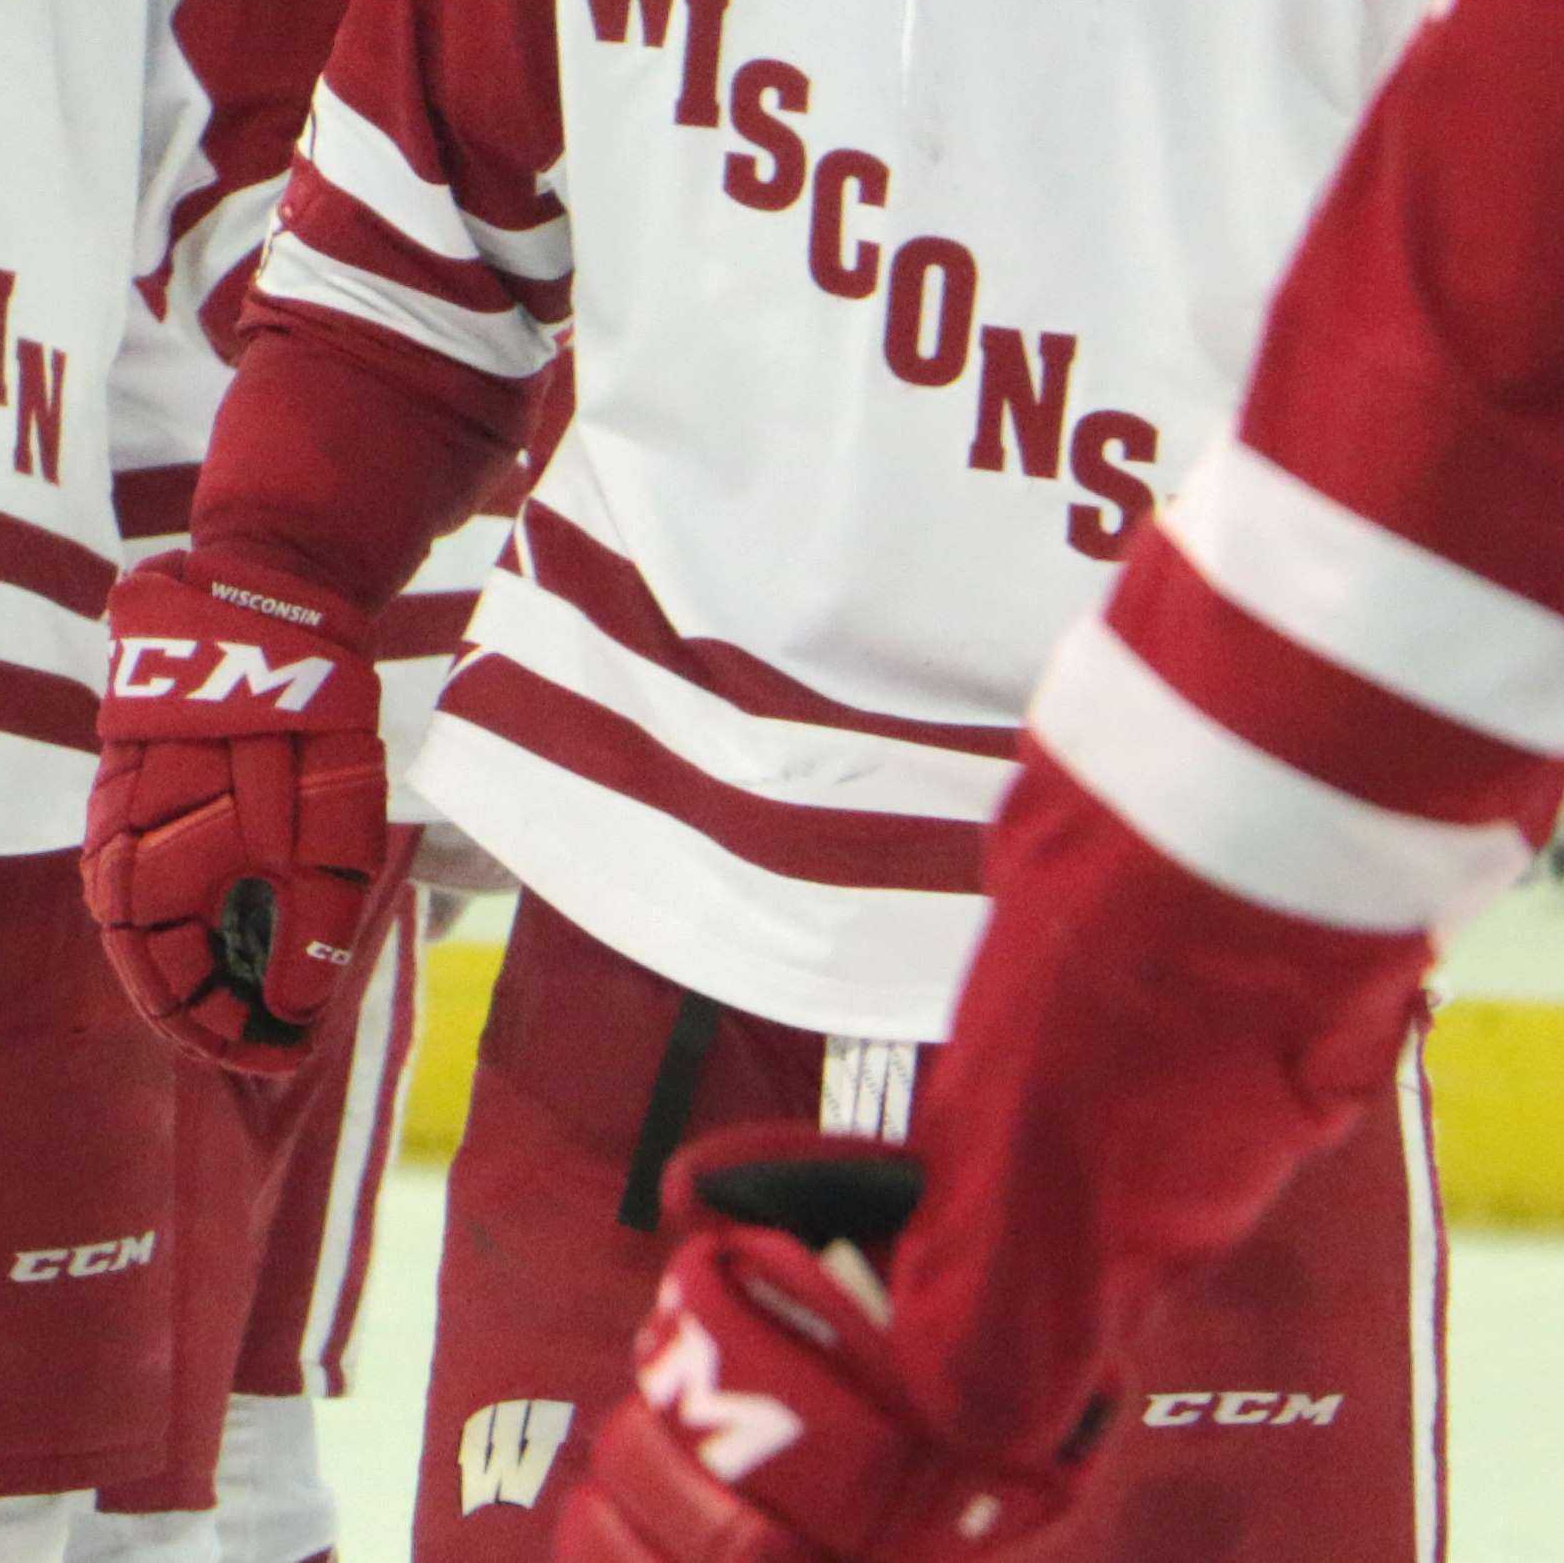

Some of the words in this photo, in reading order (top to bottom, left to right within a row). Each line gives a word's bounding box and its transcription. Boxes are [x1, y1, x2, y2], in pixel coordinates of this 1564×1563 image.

[209, 580, 323, 628] WISCONSIN
[109, 636, 335, 713] CM
[304, 939, 351, 966] CC
[9, 1229, 156, 1283] CCM
[1141, 1391, 1344, 1428] CCM
[457, 1398, 577, 1518] W
